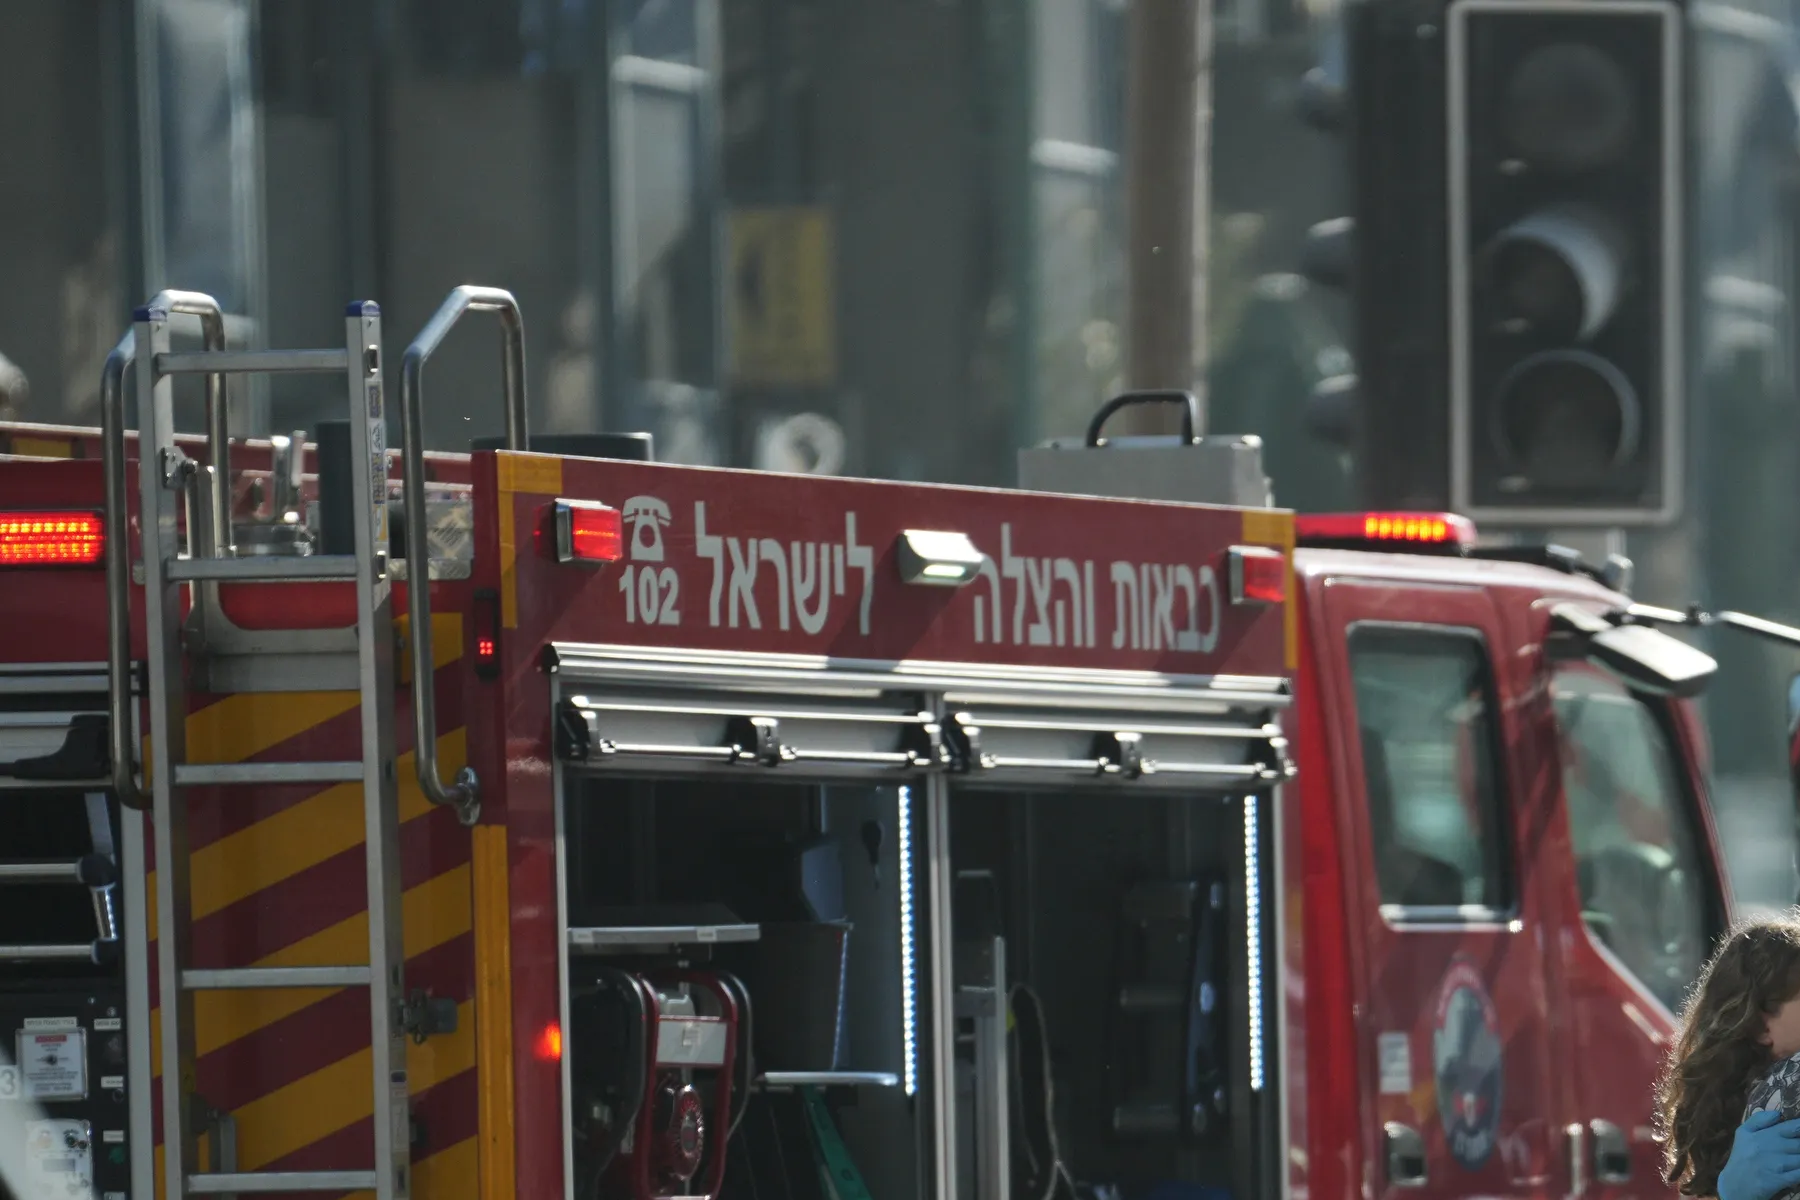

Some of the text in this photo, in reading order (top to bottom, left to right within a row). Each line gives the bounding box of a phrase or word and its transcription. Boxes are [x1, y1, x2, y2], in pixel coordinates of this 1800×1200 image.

[619, 564, 680, 626] 102
[694, 500, 1220, 653] כבאות והצלה לישראל
